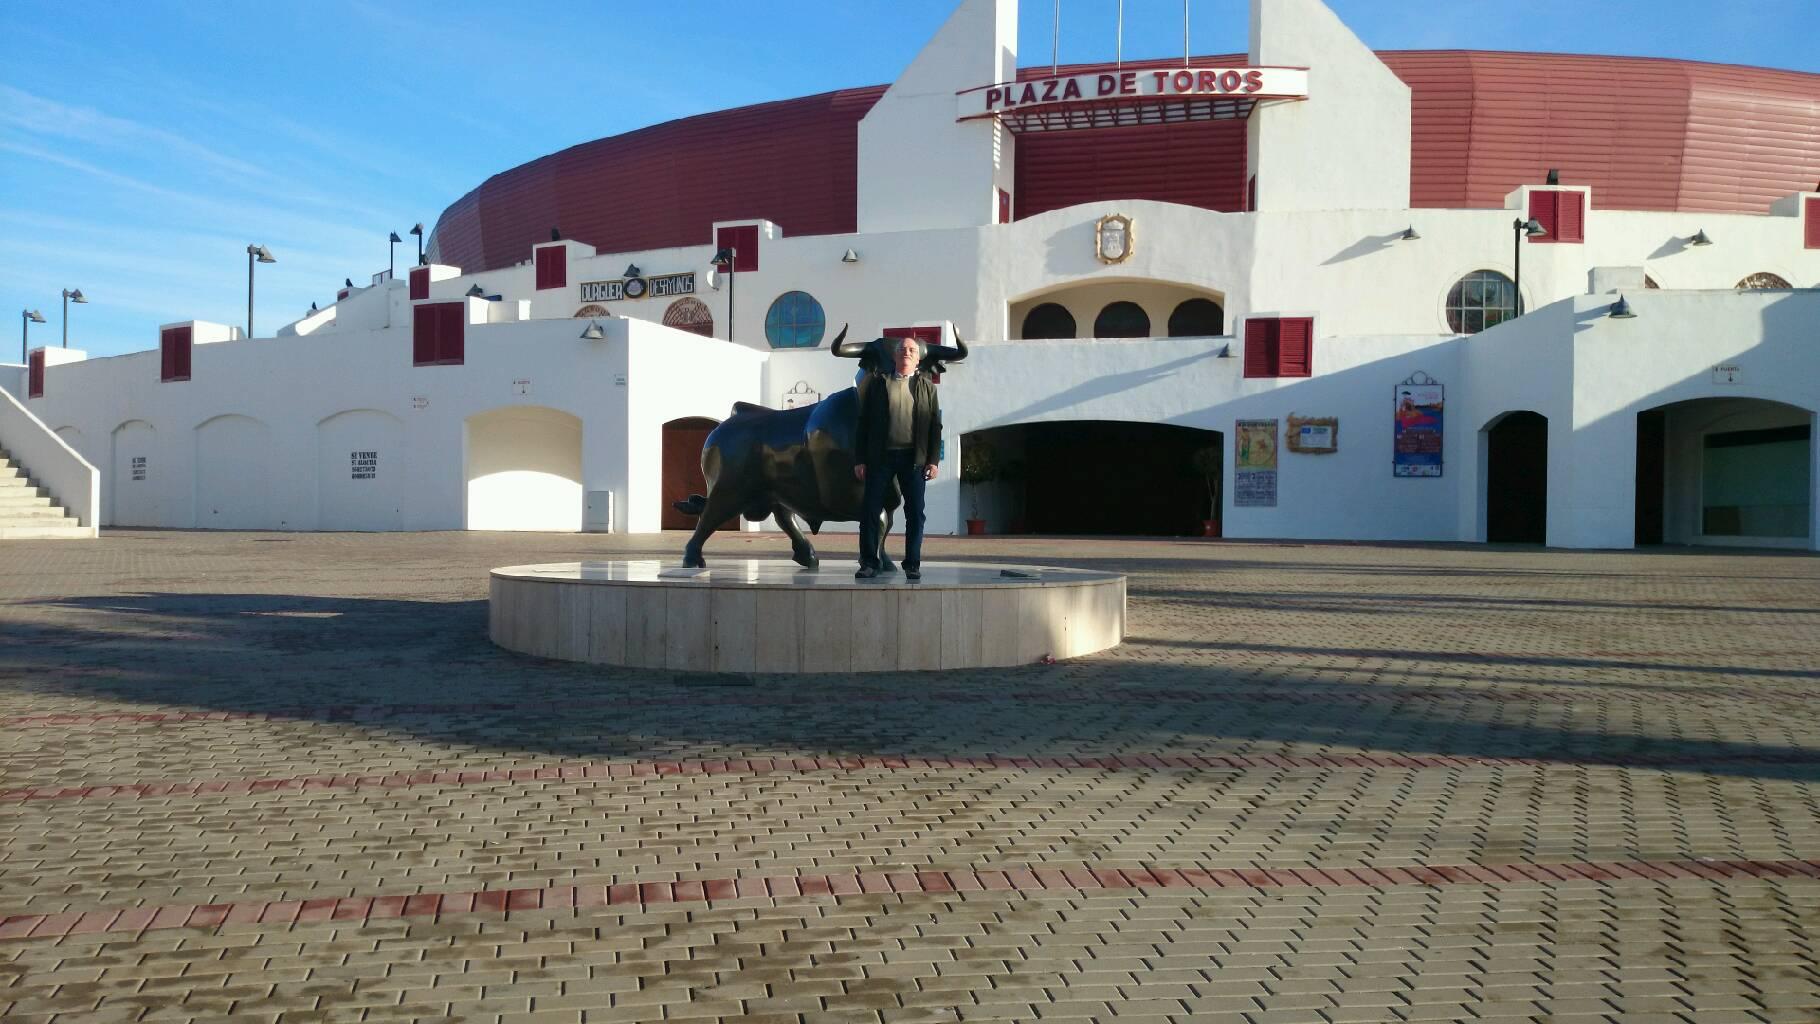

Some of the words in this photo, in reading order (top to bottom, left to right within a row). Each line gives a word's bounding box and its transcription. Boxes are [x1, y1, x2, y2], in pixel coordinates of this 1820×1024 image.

[985, 78, 1082, 110] PLAZA
[1097, 72, 1137, 96] DE
[1153, 70, 1264, 93] TOROS
[649, 274, 694, 297] DESAYUNOS
